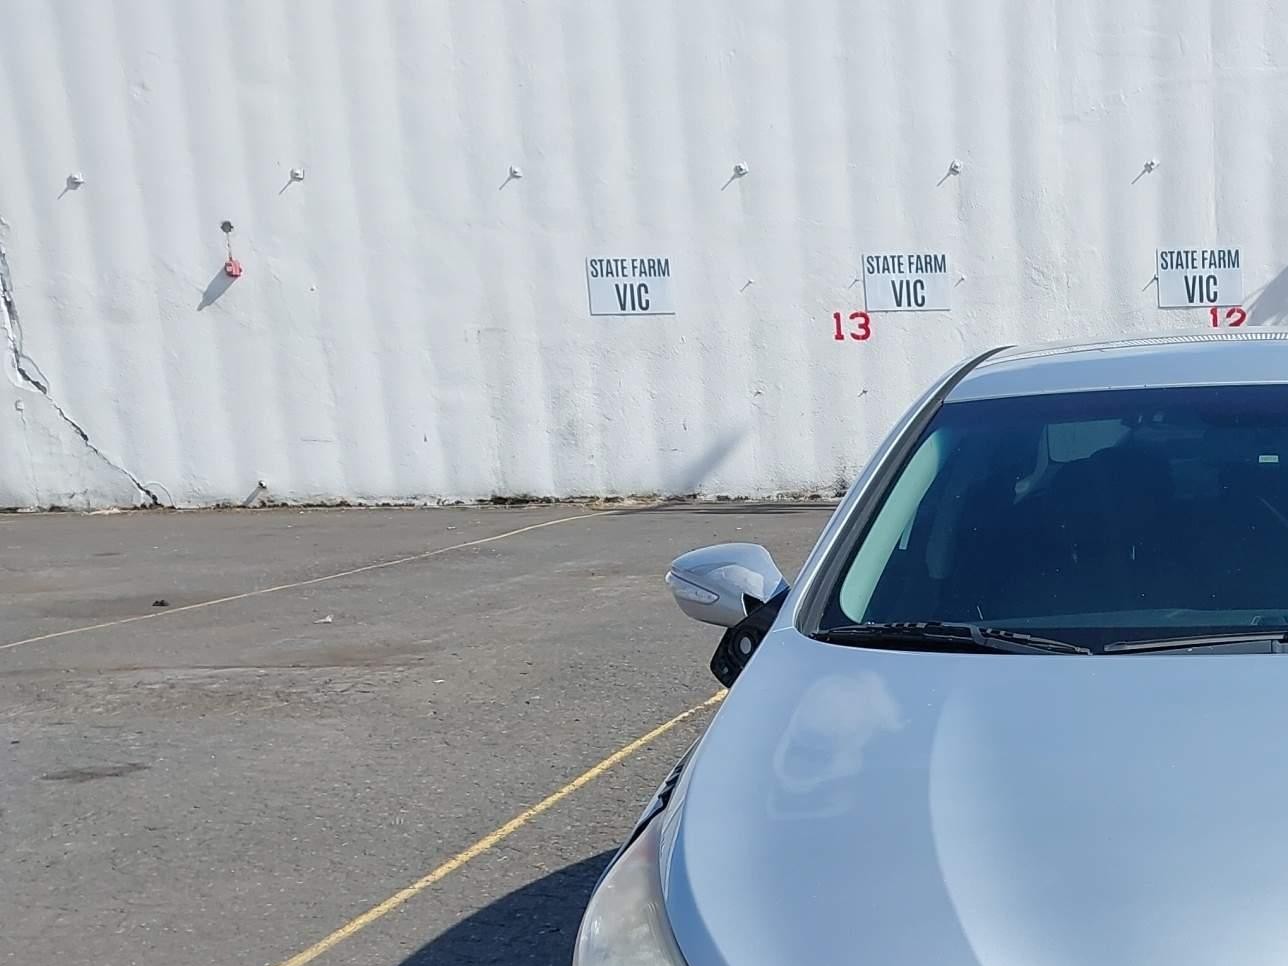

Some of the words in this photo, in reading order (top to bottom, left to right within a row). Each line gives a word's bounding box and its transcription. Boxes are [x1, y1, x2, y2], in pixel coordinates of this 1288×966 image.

[590, 258, 628, 278] STATE
[631, 258, 670, 277] FARM
[866, 254, 904, 275] STATE
[908, 254, 947, 274] FARM
[1160, 250, 1197, 270] STATE
[1201, 249, 1240, 269] FARM
[615, 283, 650, 311] VIC
[891, 279, 926, 307] VIC
[1184, 274, 1218, 303] VIC
[833, 312, 871, 341] 13
[1209, 306, 1247, 328] 12
